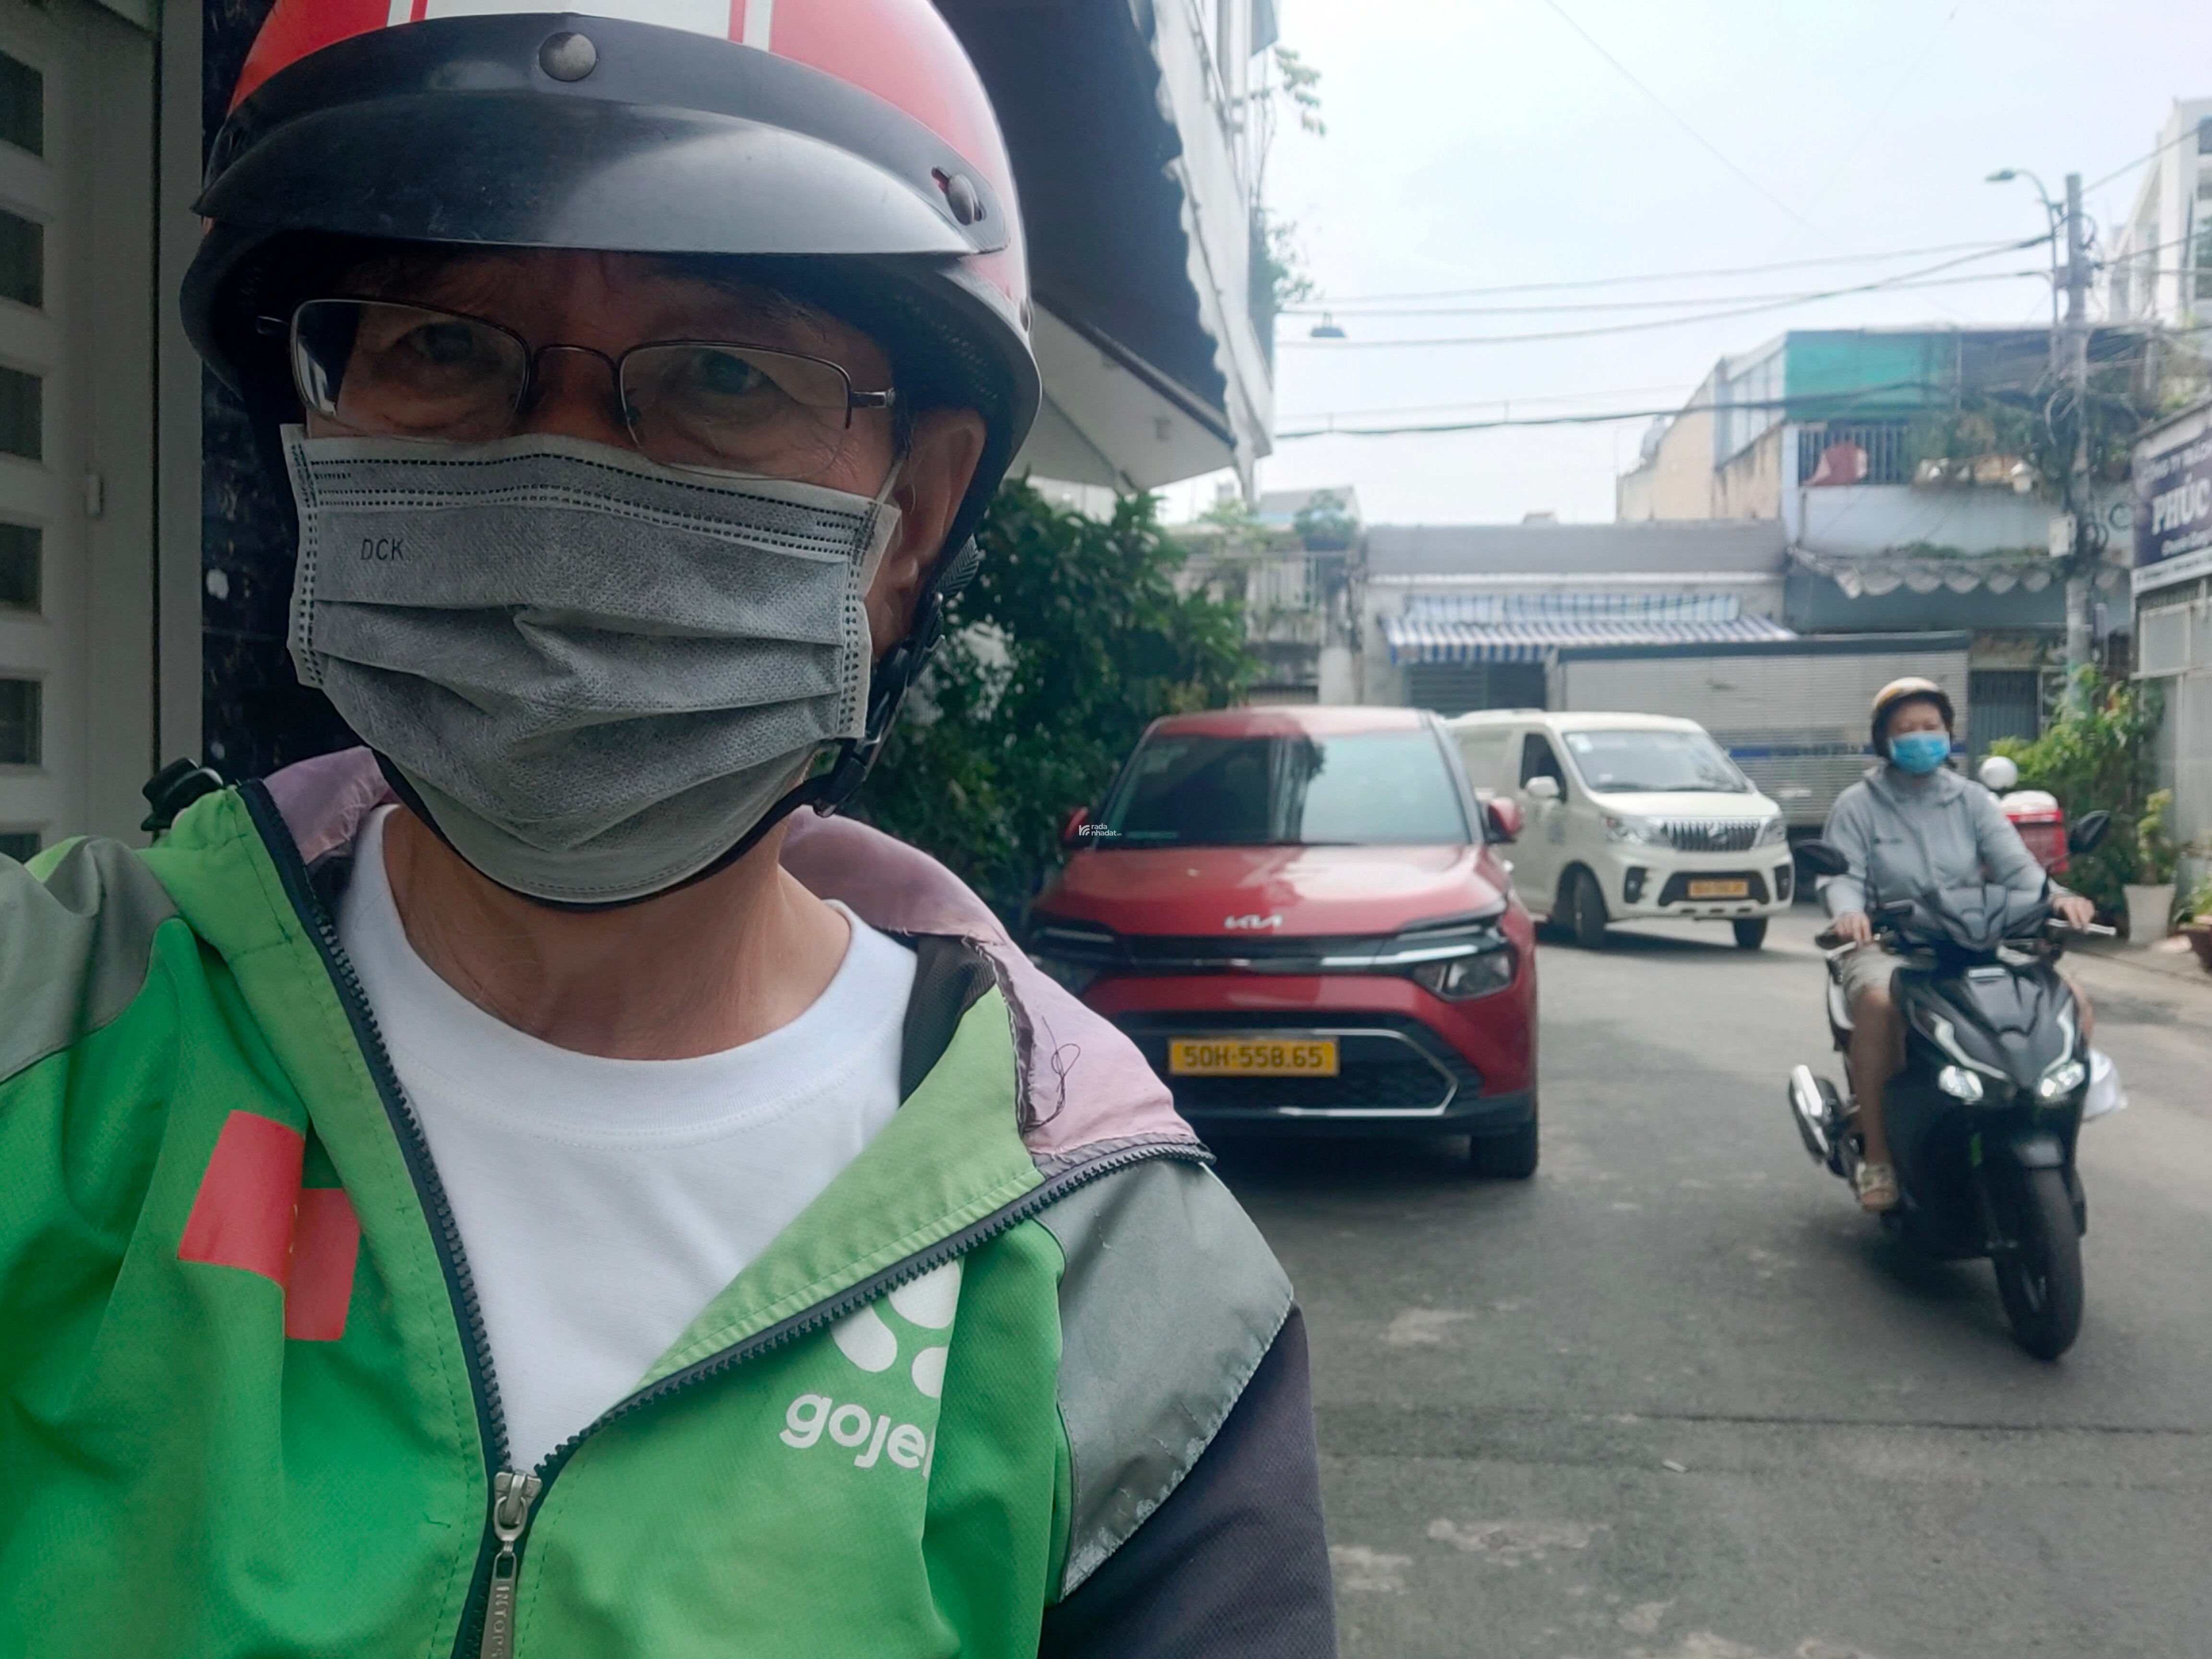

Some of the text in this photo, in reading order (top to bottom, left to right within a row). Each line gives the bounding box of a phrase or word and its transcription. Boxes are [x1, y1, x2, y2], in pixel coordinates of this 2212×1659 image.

[361, 538, 404, 561] DCK
[1224, 913, 1283, 929] KIA
[1183, 1045, 1323, 1068] 50H-558.65
[779, 1394, 936, 1479] goje
